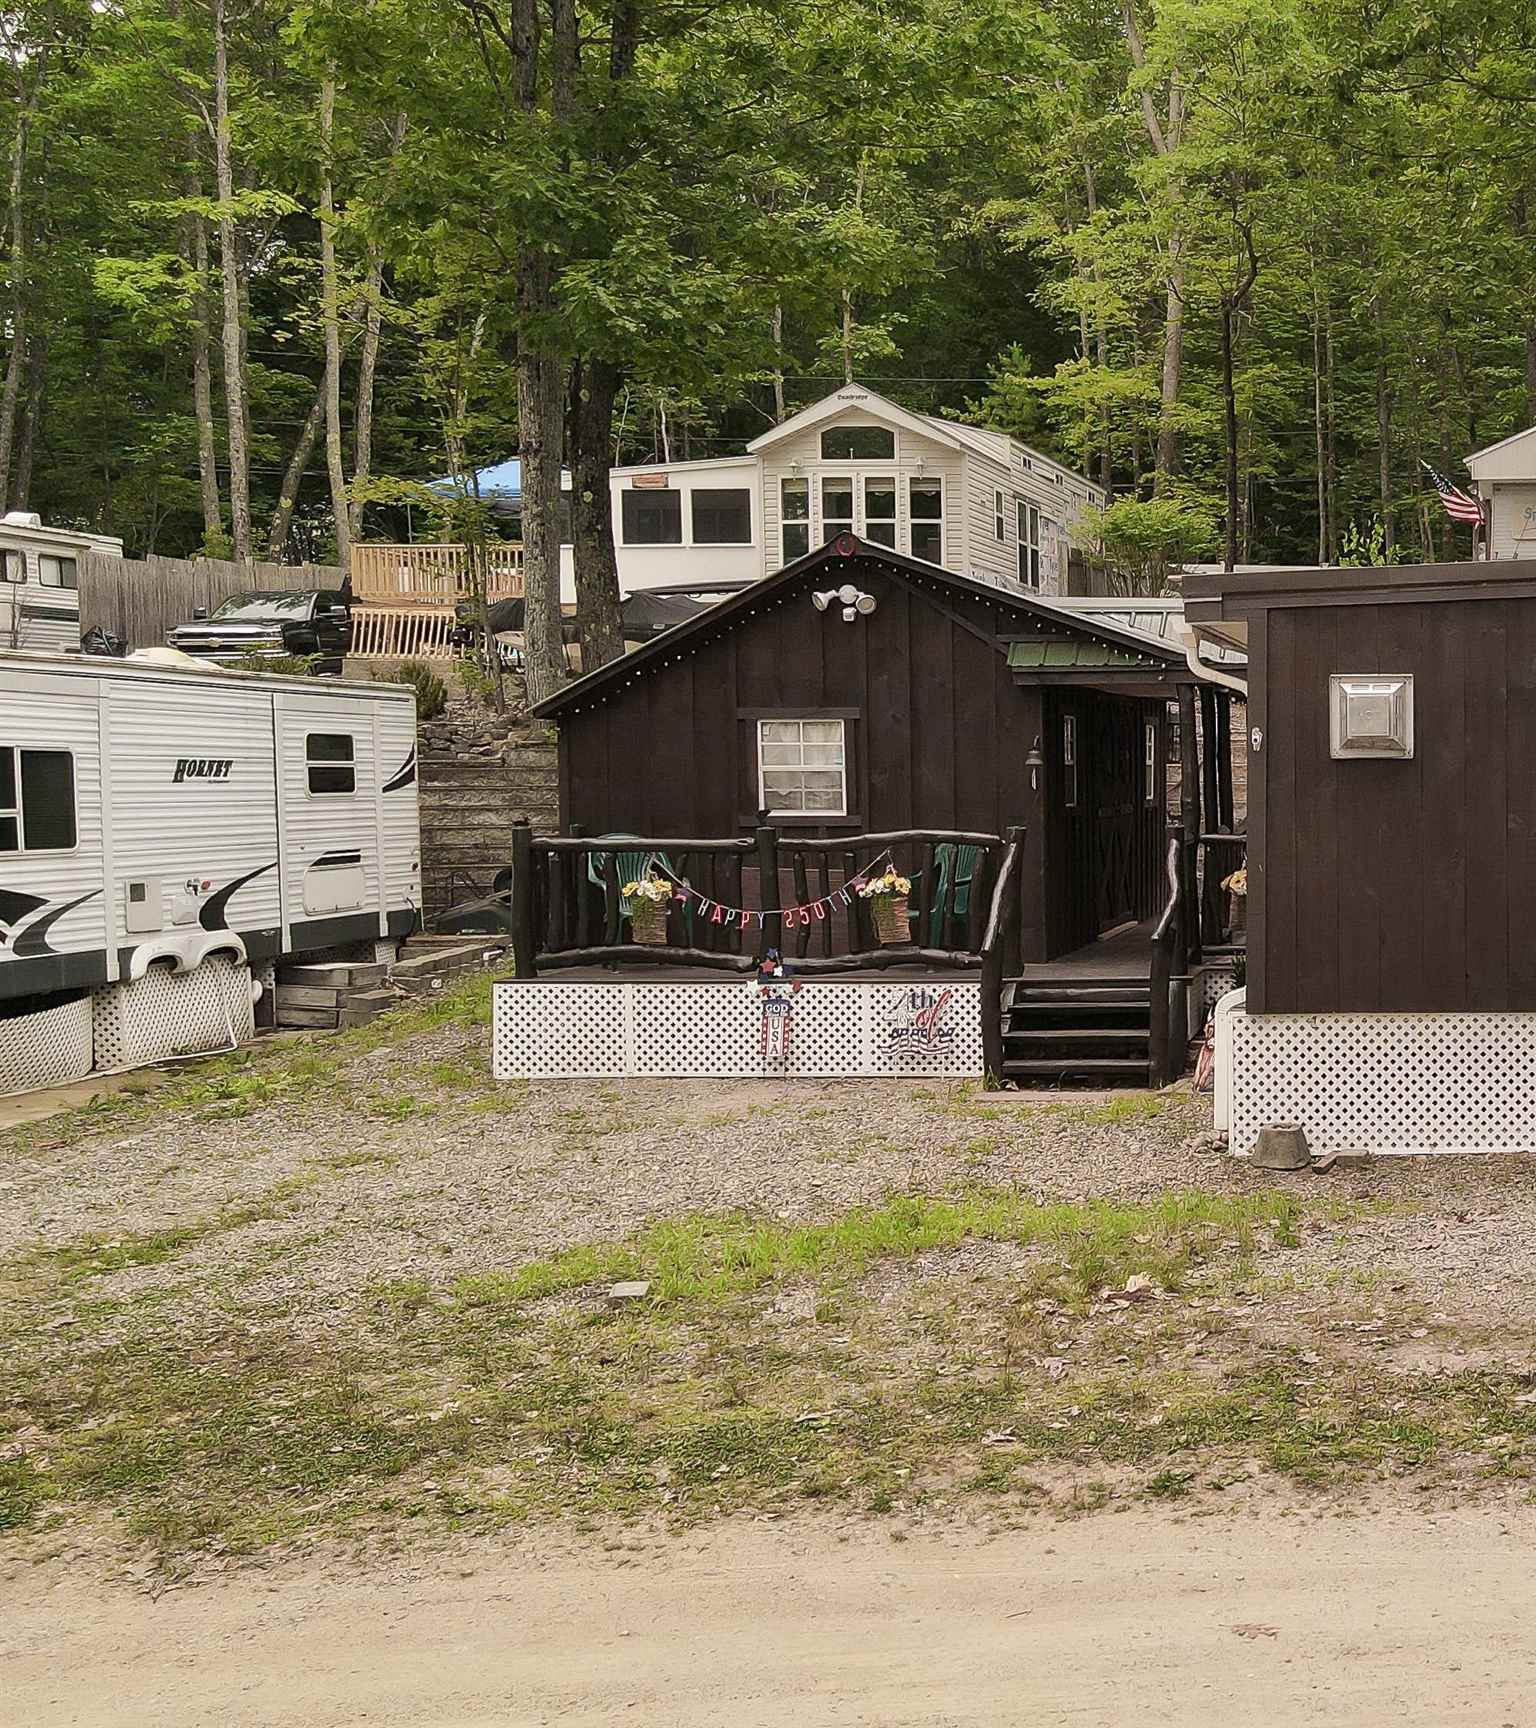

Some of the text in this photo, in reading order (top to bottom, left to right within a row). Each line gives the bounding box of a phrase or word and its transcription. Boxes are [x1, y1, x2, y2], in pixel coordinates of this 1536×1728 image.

[172, 759, 234, 783] HORNET
[698, 887, 852, 929] HAPPY 250TH
[770, 1018, 780, 1055] USA
